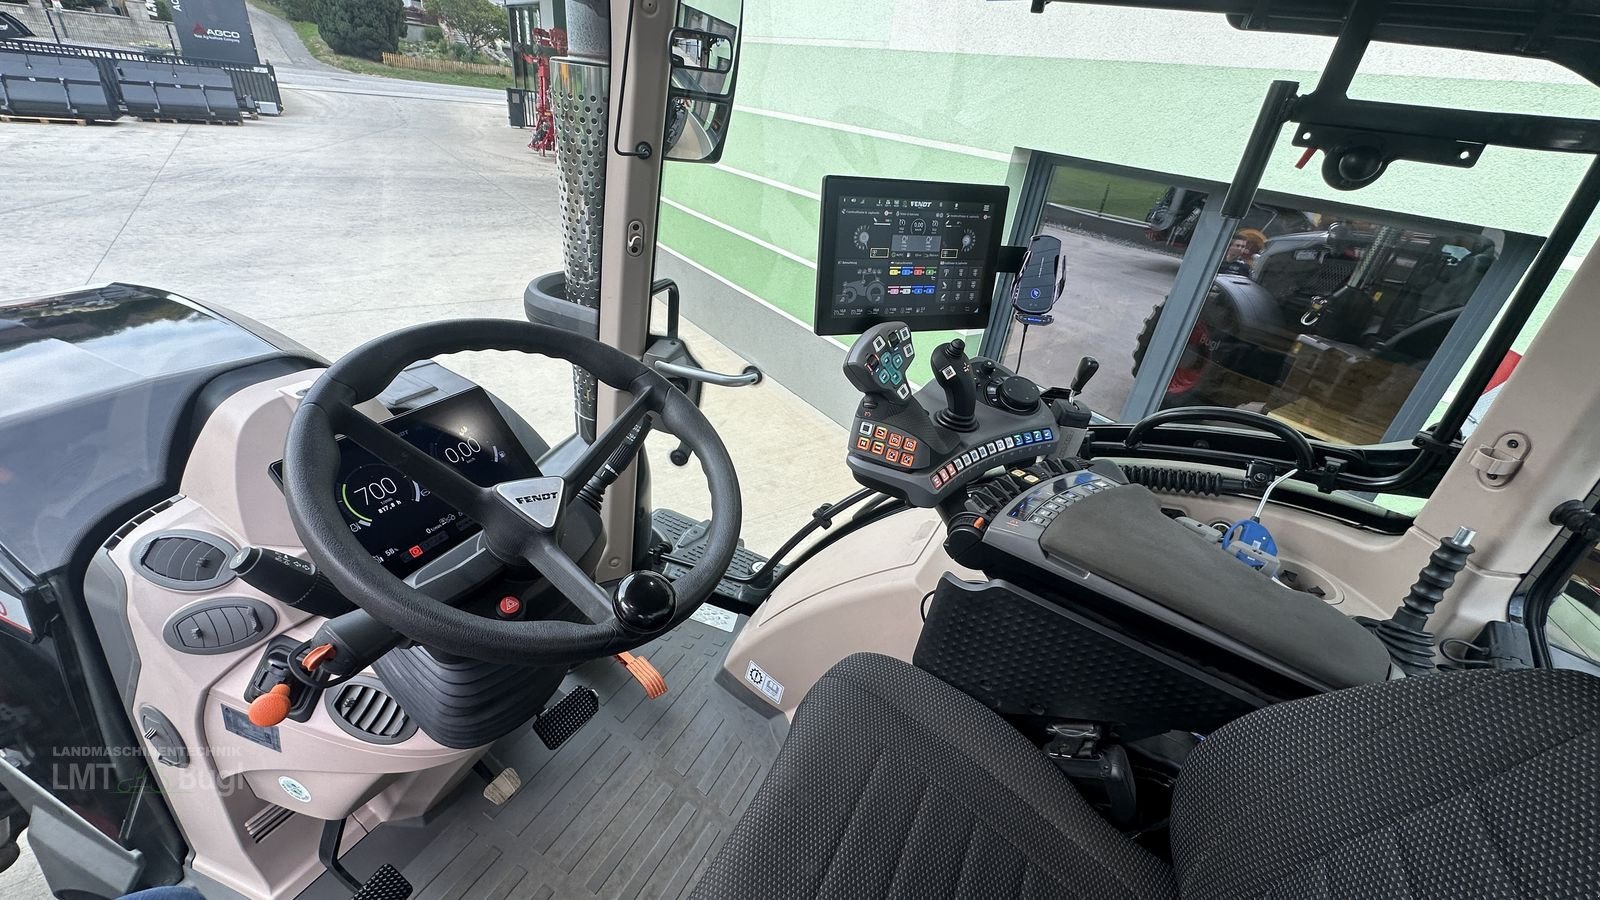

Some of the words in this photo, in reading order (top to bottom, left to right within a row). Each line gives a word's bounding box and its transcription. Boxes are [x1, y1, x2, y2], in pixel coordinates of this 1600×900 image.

[206, 28, 240, 39] AGCO
[353, 477, 397, 506] 700
[515, 492, 558, 504] FENDT
